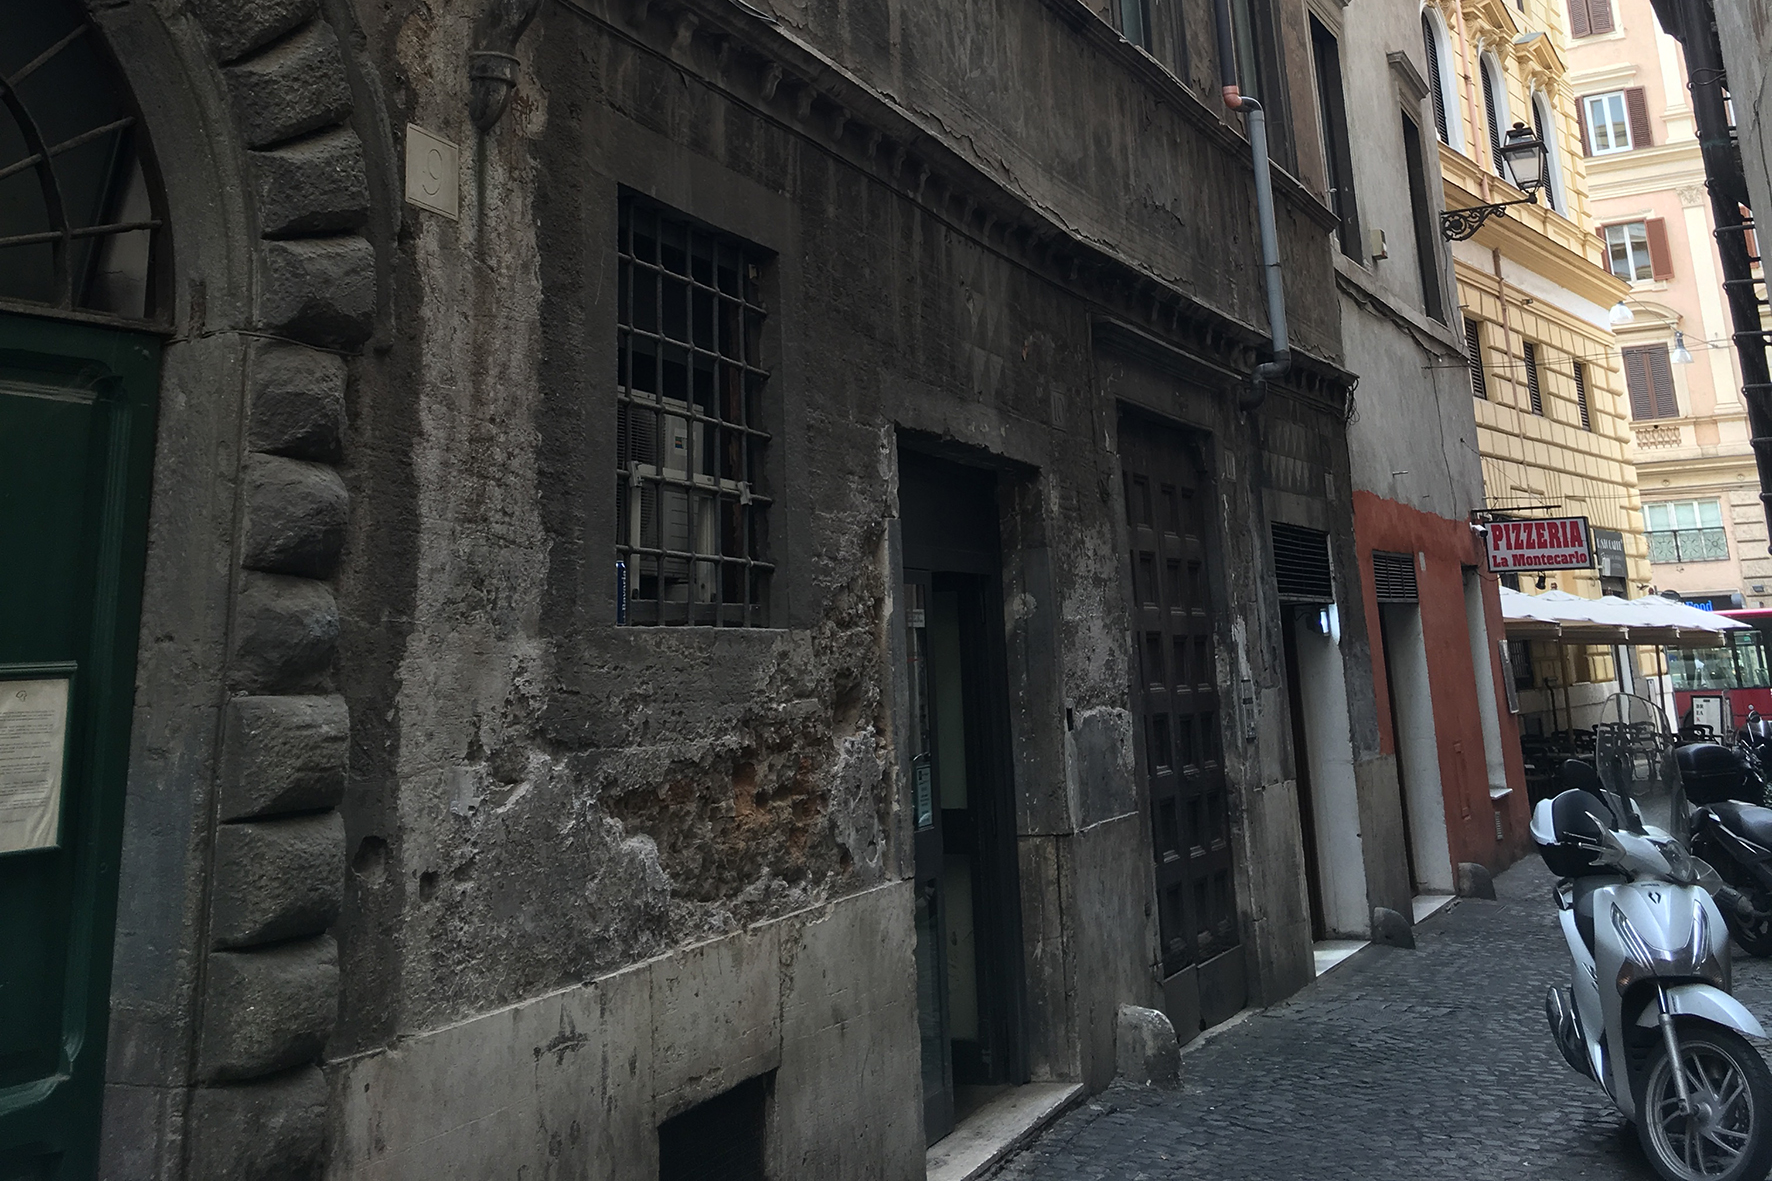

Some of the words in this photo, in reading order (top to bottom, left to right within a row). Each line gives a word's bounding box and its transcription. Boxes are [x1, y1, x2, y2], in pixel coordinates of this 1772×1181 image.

[422, 148, 443, 196] 9
[1490, 520, 1584, 551] PIZZERIA
[1491, 554, 1509, 568] La
[1511, 551, 1588, 567] Montecarlo
